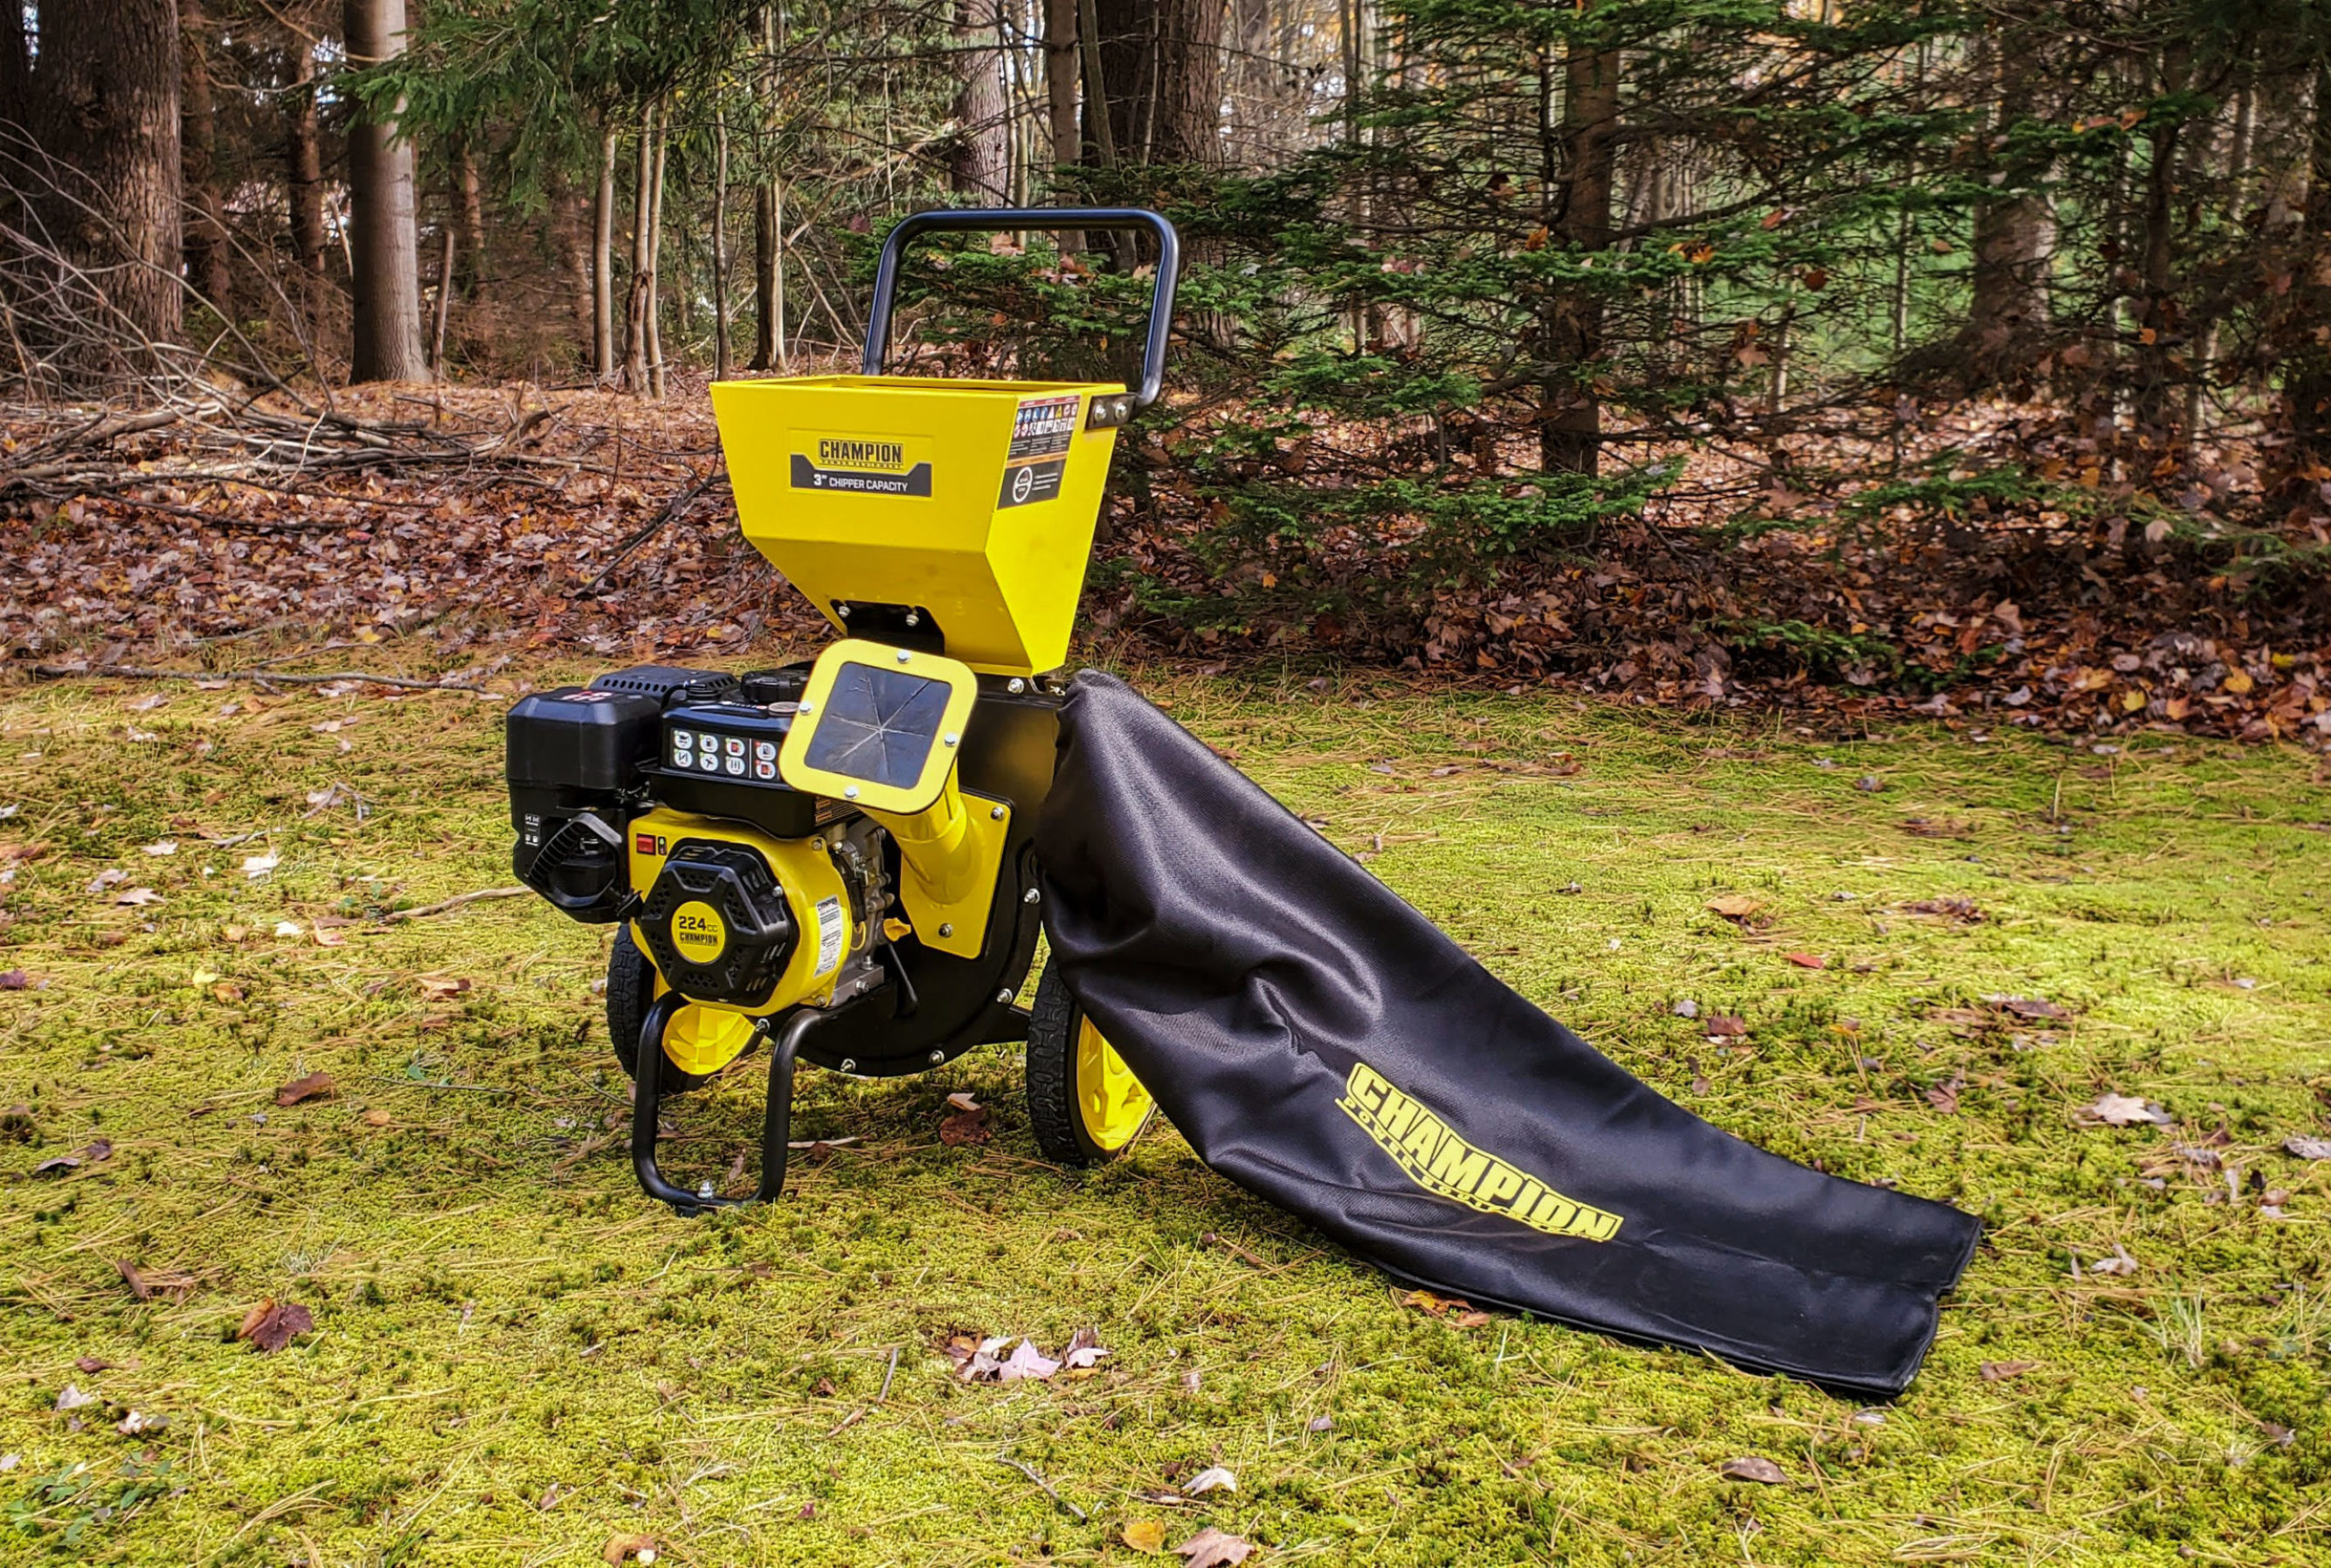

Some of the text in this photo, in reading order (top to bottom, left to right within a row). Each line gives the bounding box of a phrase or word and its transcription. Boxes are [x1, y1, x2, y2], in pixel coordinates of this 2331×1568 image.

[820, 440, 902, 464] CHAMPION
[829, 477, 865, 490] CHIPPER
[866, 480, 908, 492] CAPACITY
[680, 932, 718, 945] CHAMPION
[1349, 1064, 1617, 1240] CHAMPION
